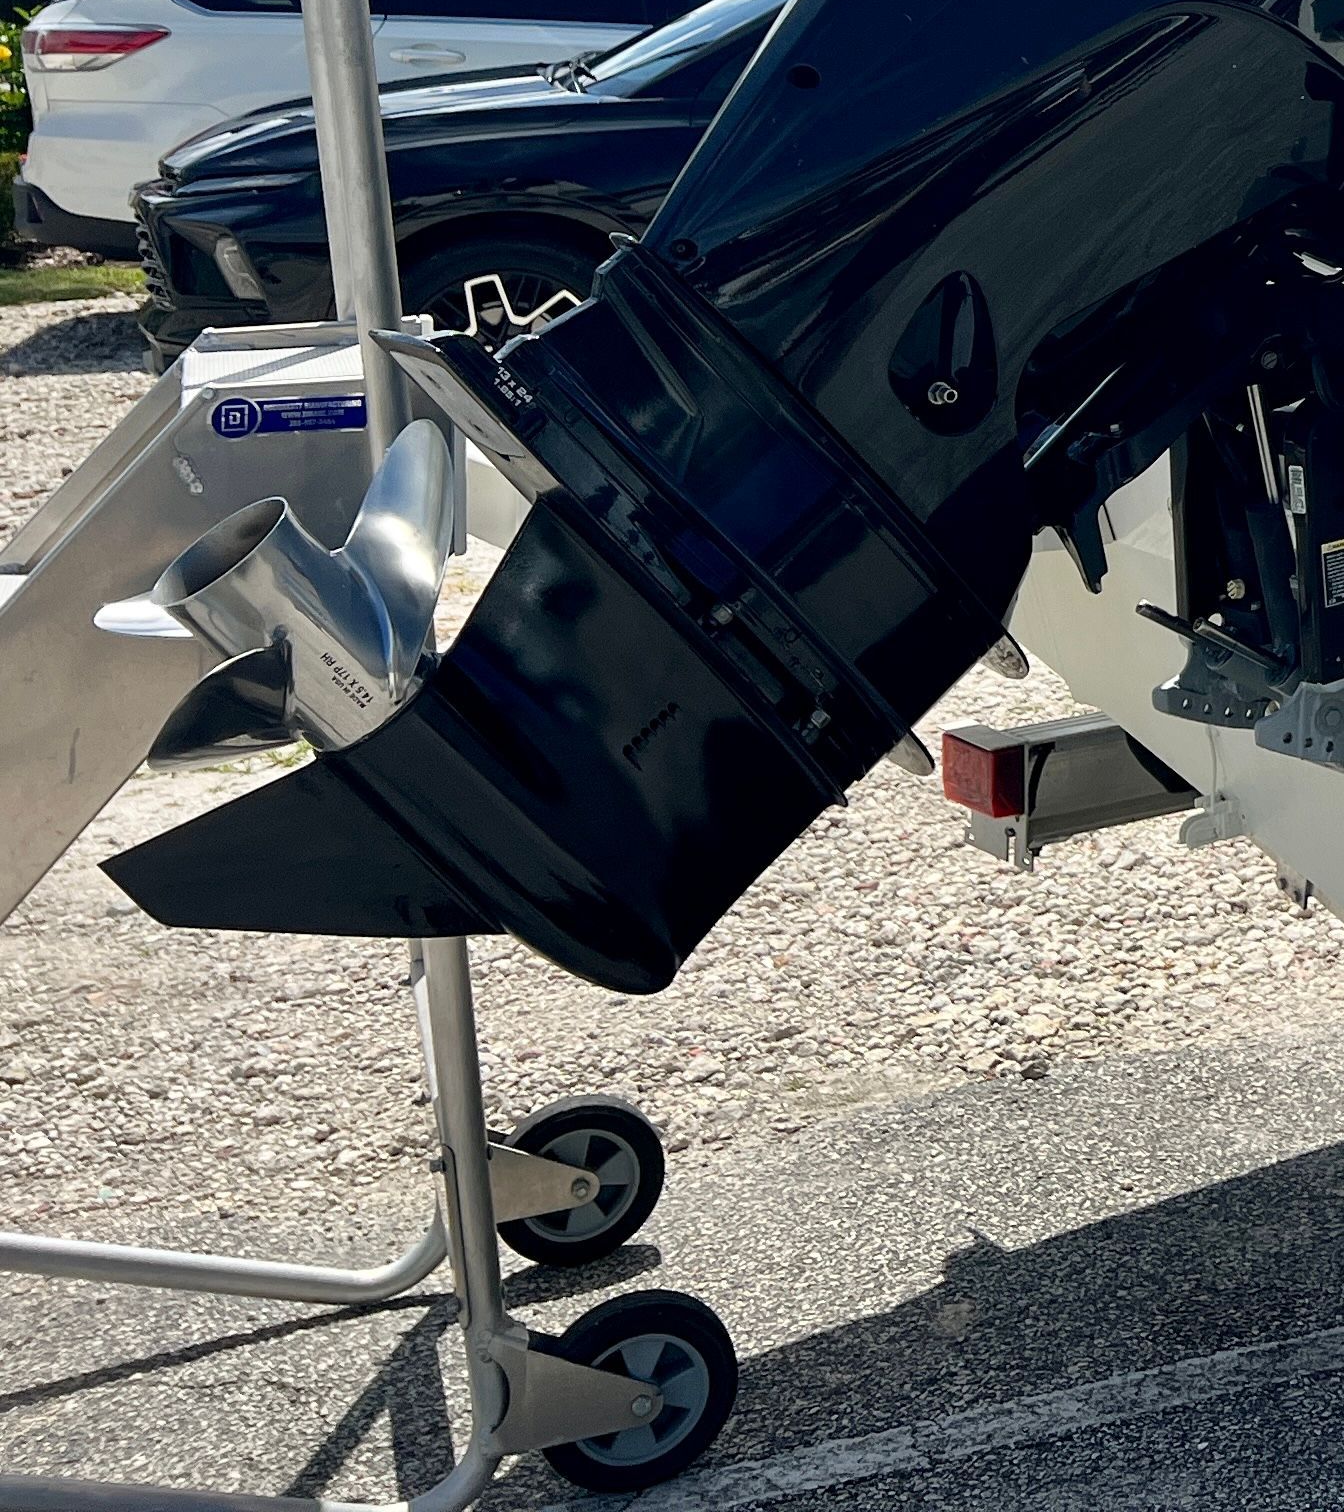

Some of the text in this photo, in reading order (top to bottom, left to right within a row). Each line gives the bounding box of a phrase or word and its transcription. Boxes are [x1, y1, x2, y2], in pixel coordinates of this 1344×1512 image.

[498, 366, 511, 381] 13
[516, 386, 533, 403] 24
[320, 652, 336, 666] RH
[334, 666, 350, 680] 17P
